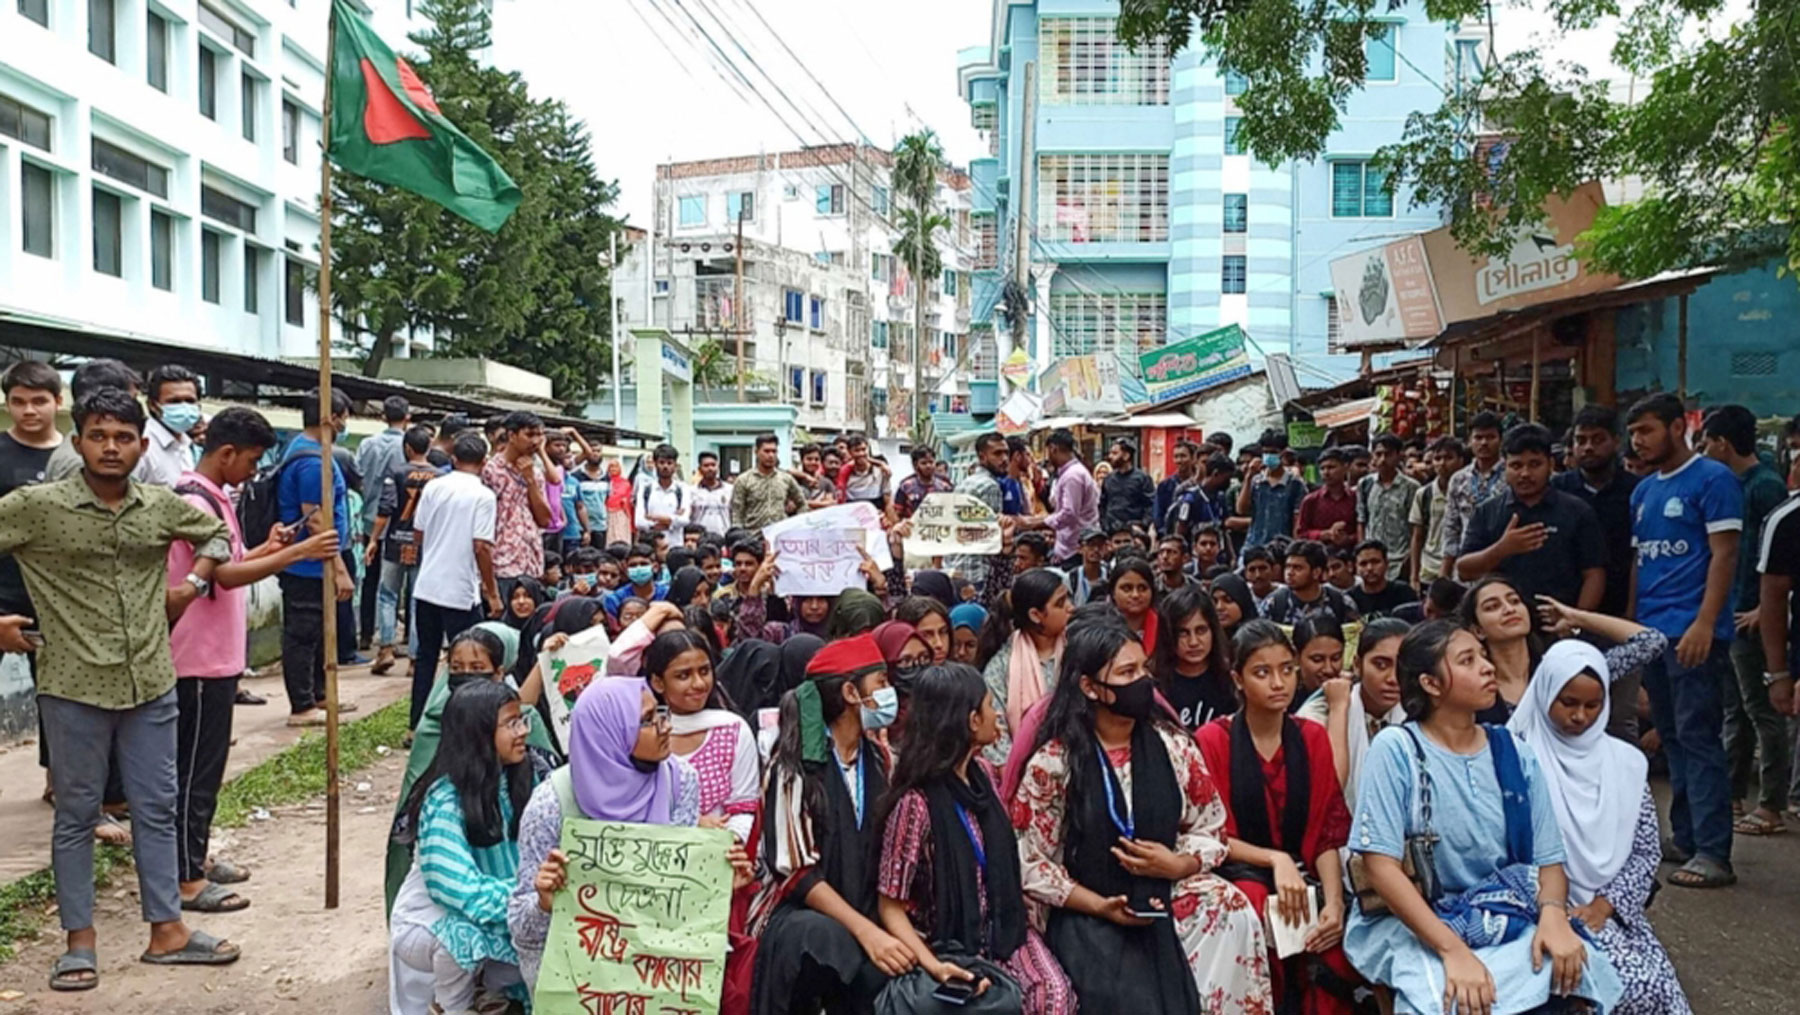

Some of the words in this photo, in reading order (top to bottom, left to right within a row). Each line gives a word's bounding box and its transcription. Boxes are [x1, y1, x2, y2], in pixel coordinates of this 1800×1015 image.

[1484, 254, 1569, 296] পোলার
[780, 539, 821, 556] আর
[602, 880, 690, 919] চেতনা
